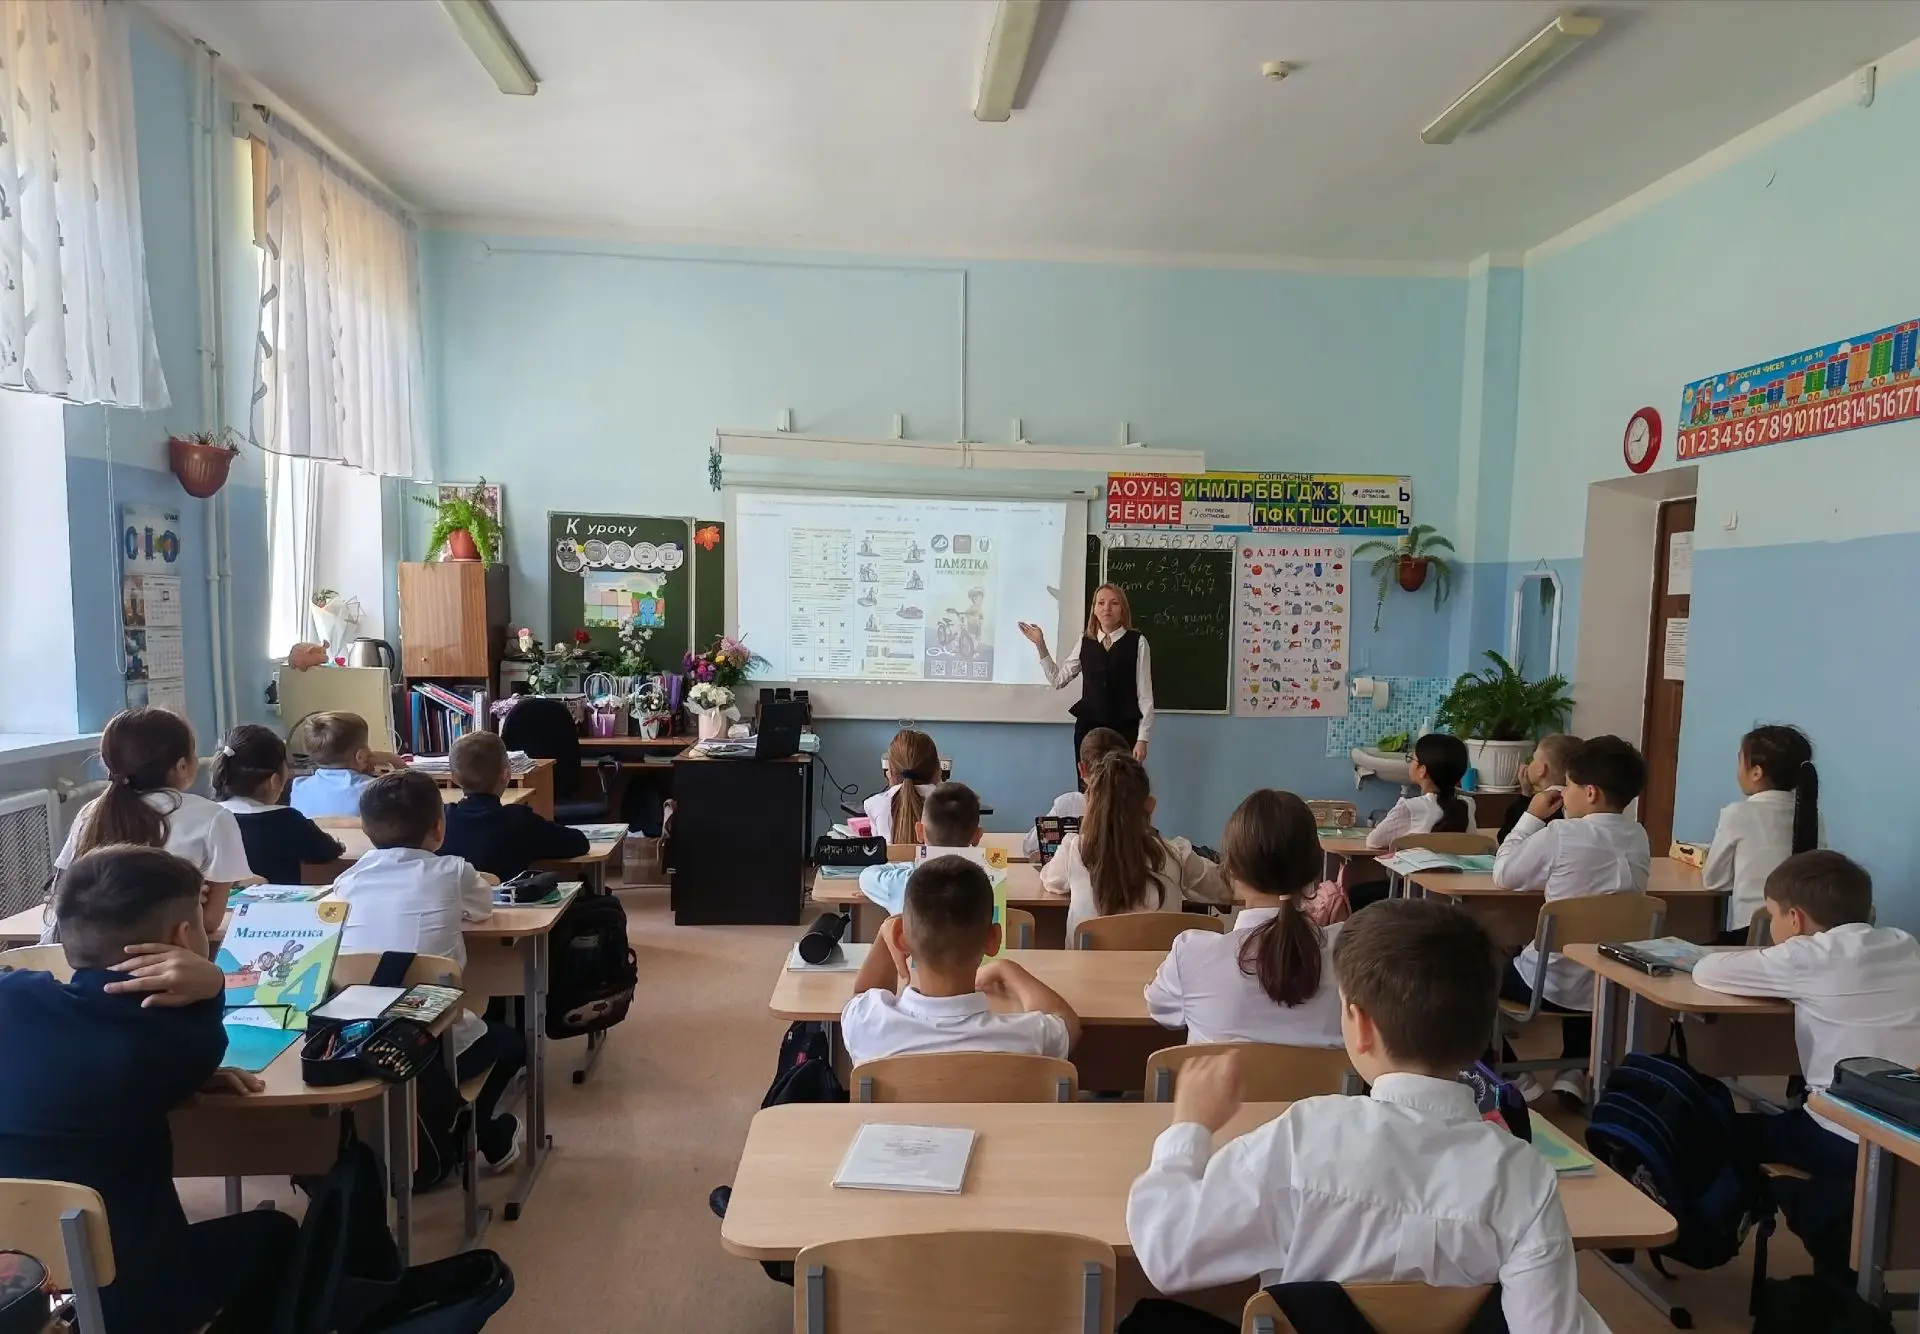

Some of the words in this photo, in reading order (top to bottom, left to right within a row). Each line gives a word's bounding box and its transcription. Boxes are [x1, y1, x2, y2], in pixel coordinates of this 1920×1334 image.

[1678, 436, 1686, 456] 0
[1690, 433, 1696, 454] 1
[1697, 430, 1707, 452] 2
[1708, 428, 1719, 450] 3
[1720, 425, 1732, 448] 4
[1733, 423, 1744, 446] 5
[1745, 420, 1756, 443] 6
[1758, 418, 1768, 442] 7
[1769, 415, 1780, 439] 8
[1782, 412, 1793, 437] 9
[1794, 409, 1807, 435] 10
[1808, 406, 1822, 432] 11
[1823, 403, 1836, 429] 12
[1837, 399, 1850, 426] 13
[1851, 396, 1865, 423] 14
[1866, 393, 1881, 421] 15
[1881, 389, 1896, 418] 16
[1897, 386, 1914, 415] 17
[1257, 473, 1315, 482] СОГЛАСНЫЕ
[566, 518, 580, 535] К
[587, 522, 638, 537] уроку
[1256, 548, 1332, 557] АЛФАВИТ
[934, 558, 989, 569] ПАМЯТКА
[234, 927, 324, 939] Математика
[277, 962, 322, 1011] 4
